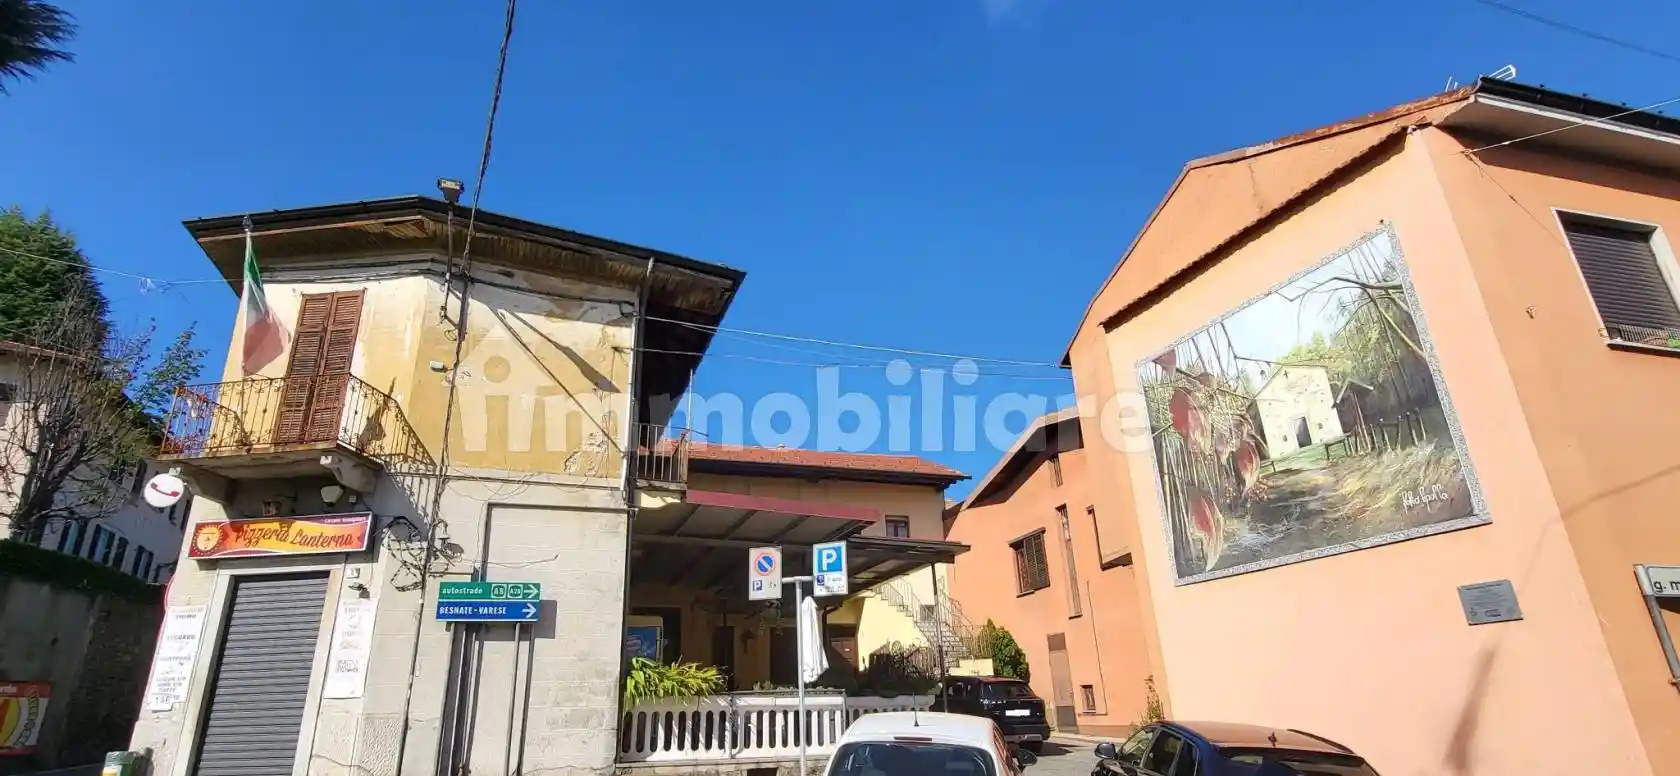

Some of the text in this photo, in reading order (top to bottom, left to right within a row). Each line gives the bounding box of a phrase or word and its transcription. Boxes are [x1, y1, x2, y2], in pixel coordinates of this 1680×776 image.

[236, 523, 353, 548] Pizzeria Lanterna
[821, 548, 838, 571] P
[1653, 580, 1667, 593] g.
